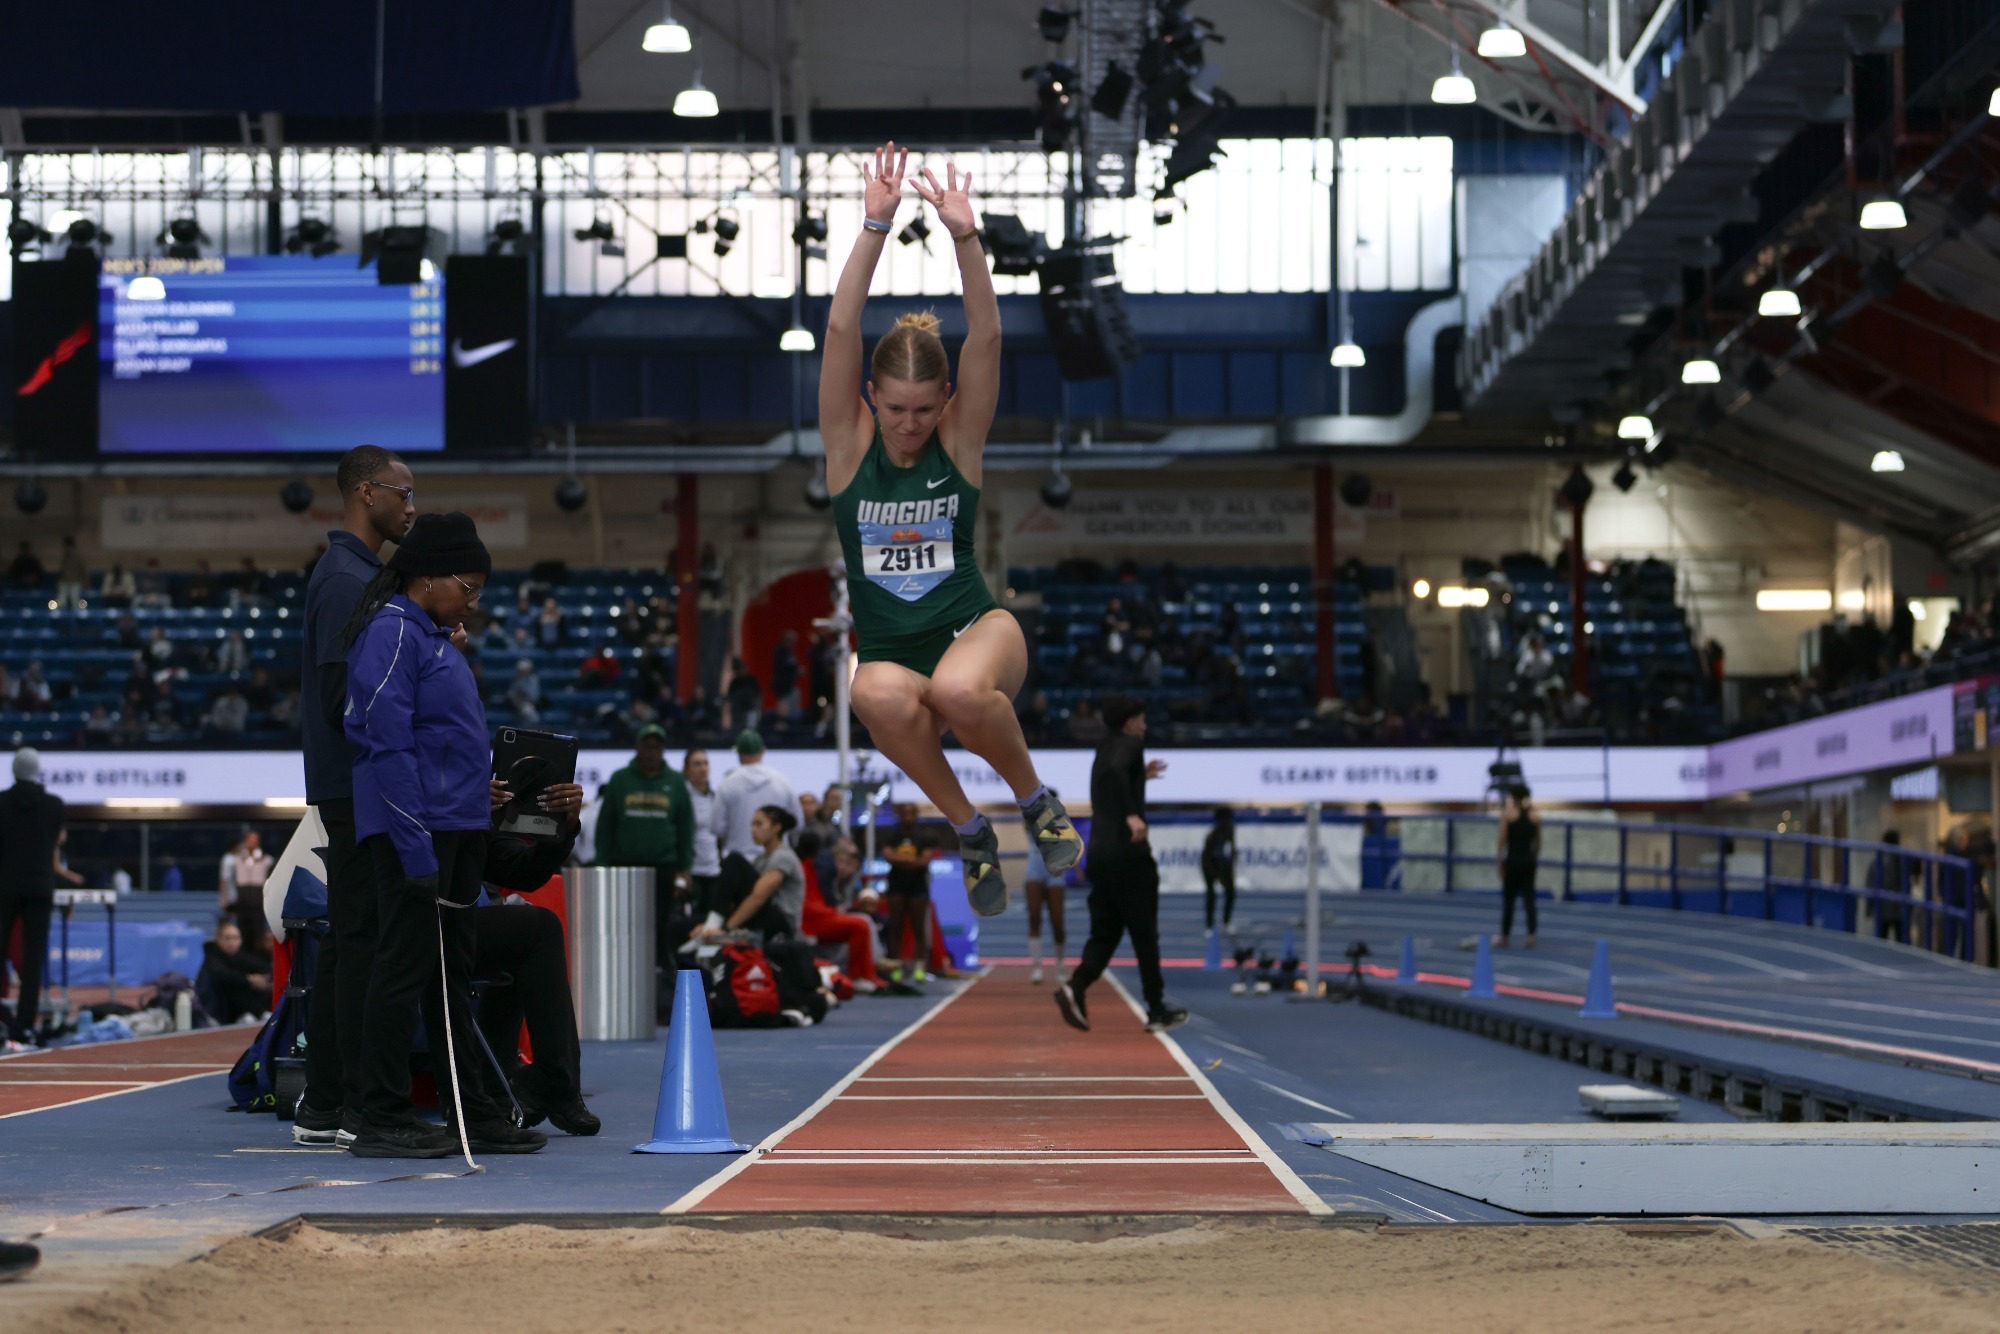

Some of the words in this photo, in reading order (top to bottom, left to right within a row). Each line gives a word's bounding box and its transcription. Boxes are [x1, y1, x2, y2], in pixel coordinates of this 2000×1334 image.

[857, 493, 959, 525] WAGNER
[1067, 499, 1122, 514] HANK
[880, 544, 936, 572] 2911
[37, 768, 86, 785] EARY
[95, 768, 187, 786] GOTTLIEB
[1261, 766, 1335, 784] CLEARY
[1345, 766, 1438, 784] GOTTLIEB
